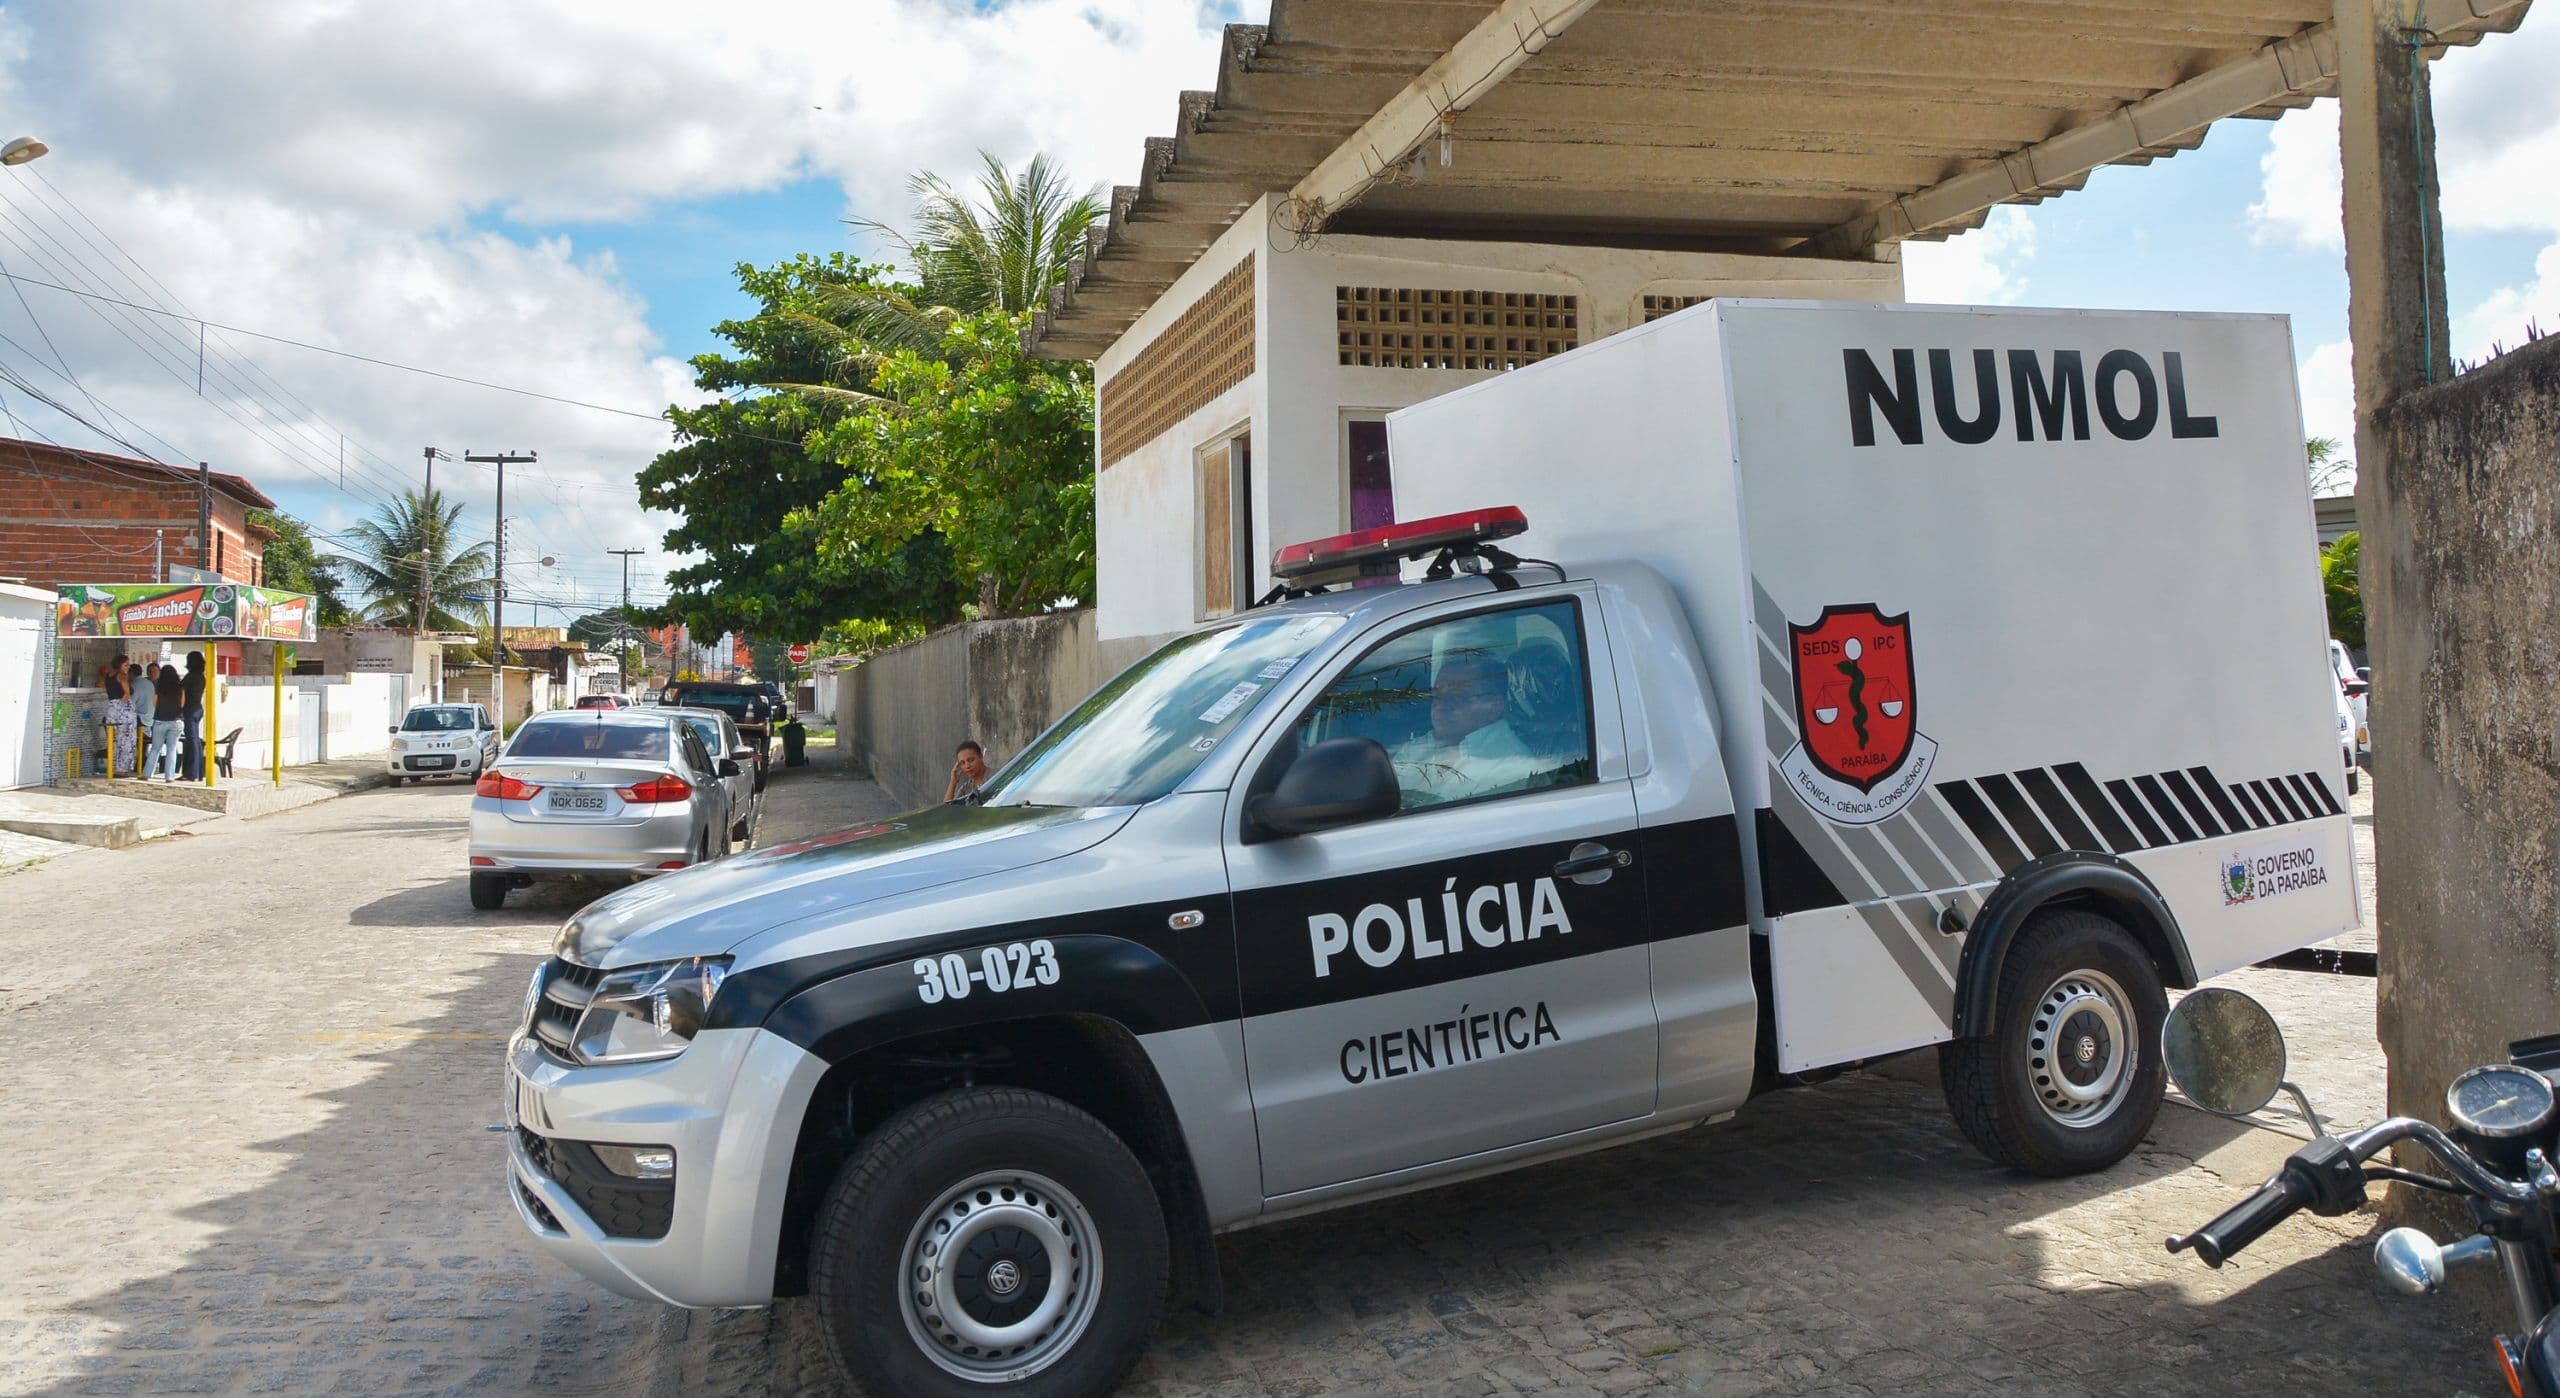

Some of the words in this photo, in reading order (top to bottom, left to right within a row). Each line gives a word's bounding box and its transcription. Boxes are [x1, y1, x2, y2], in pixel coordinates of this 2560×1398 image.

[1843, 348, 2219, 447] NUMOL
[147, 600, 193, 619] Lanches
[125, 624, 146, 632] CALDO
[146, 624, 155, 632] DE
[155, 624, 173, 632] CANA
[1872, 635, 1896, 651] IPC
[1802, 640, 1840, 656] SEDS
[1841, 752, 1888, 768] PARAÍBA
[1797, 769, 1830, 806] TÉCNICA
[1837, 801, 1873, 814] CIÊNCIA
[1878, 756, 1926, 809] CONSCIÊNCIA
[2257, 848, 2315, 877] GOVERNO
[2258, 879, 2276, 898] DA
[2277, 865, 2327, 894] PARAÍBA
[1308, 877, 1573, 978] POLÍCIA
[913, 939, 1060, 1004] 30-023
[1340, 1001, 1561, 1084] CIENTÍFICA
